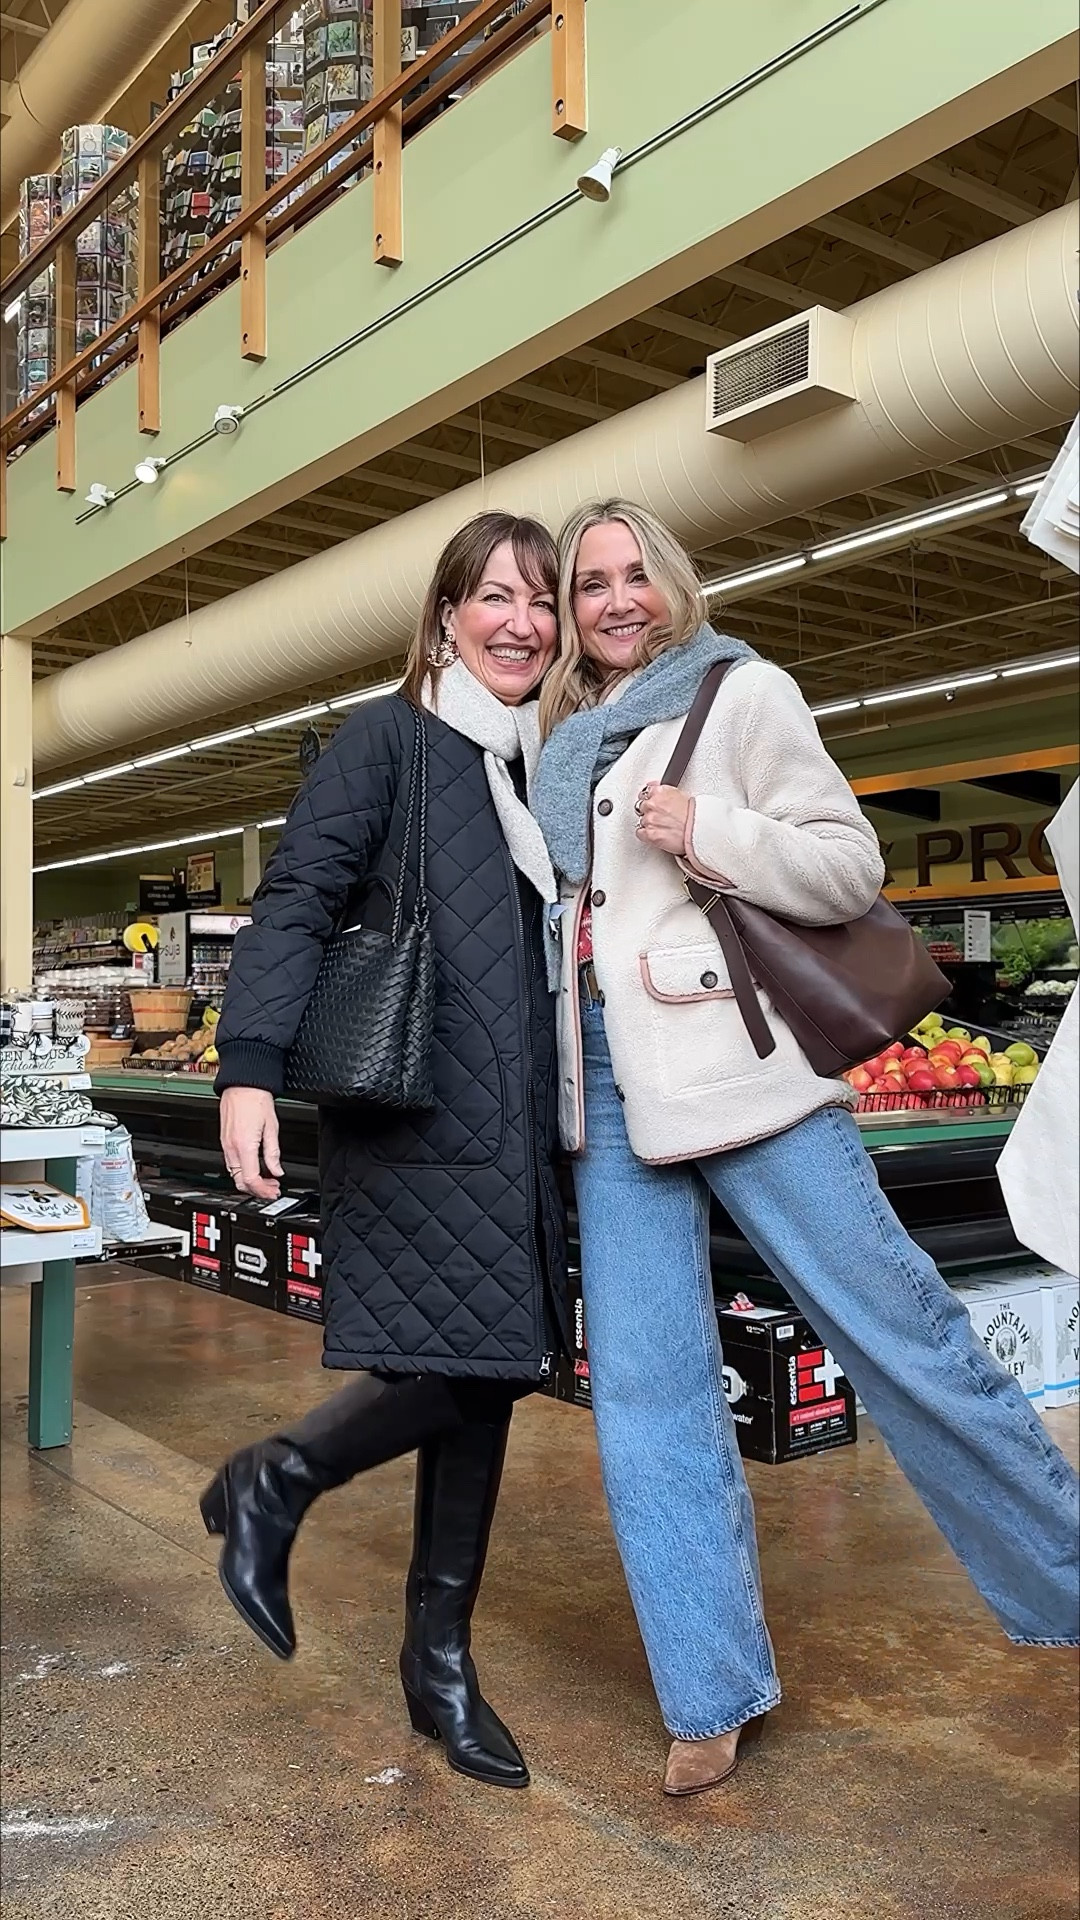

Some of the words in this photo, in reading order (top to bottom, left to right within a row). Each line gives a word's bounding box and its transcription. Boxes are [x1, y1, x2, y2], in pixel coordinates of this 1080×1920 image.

[574, 1298, 583, 1349] essentia
[999, 1302, 1011, 1311] THE
[983, 1311, 1031, 1350] MOUNTAIN
[788, 1355, 798, 1406] essentia
